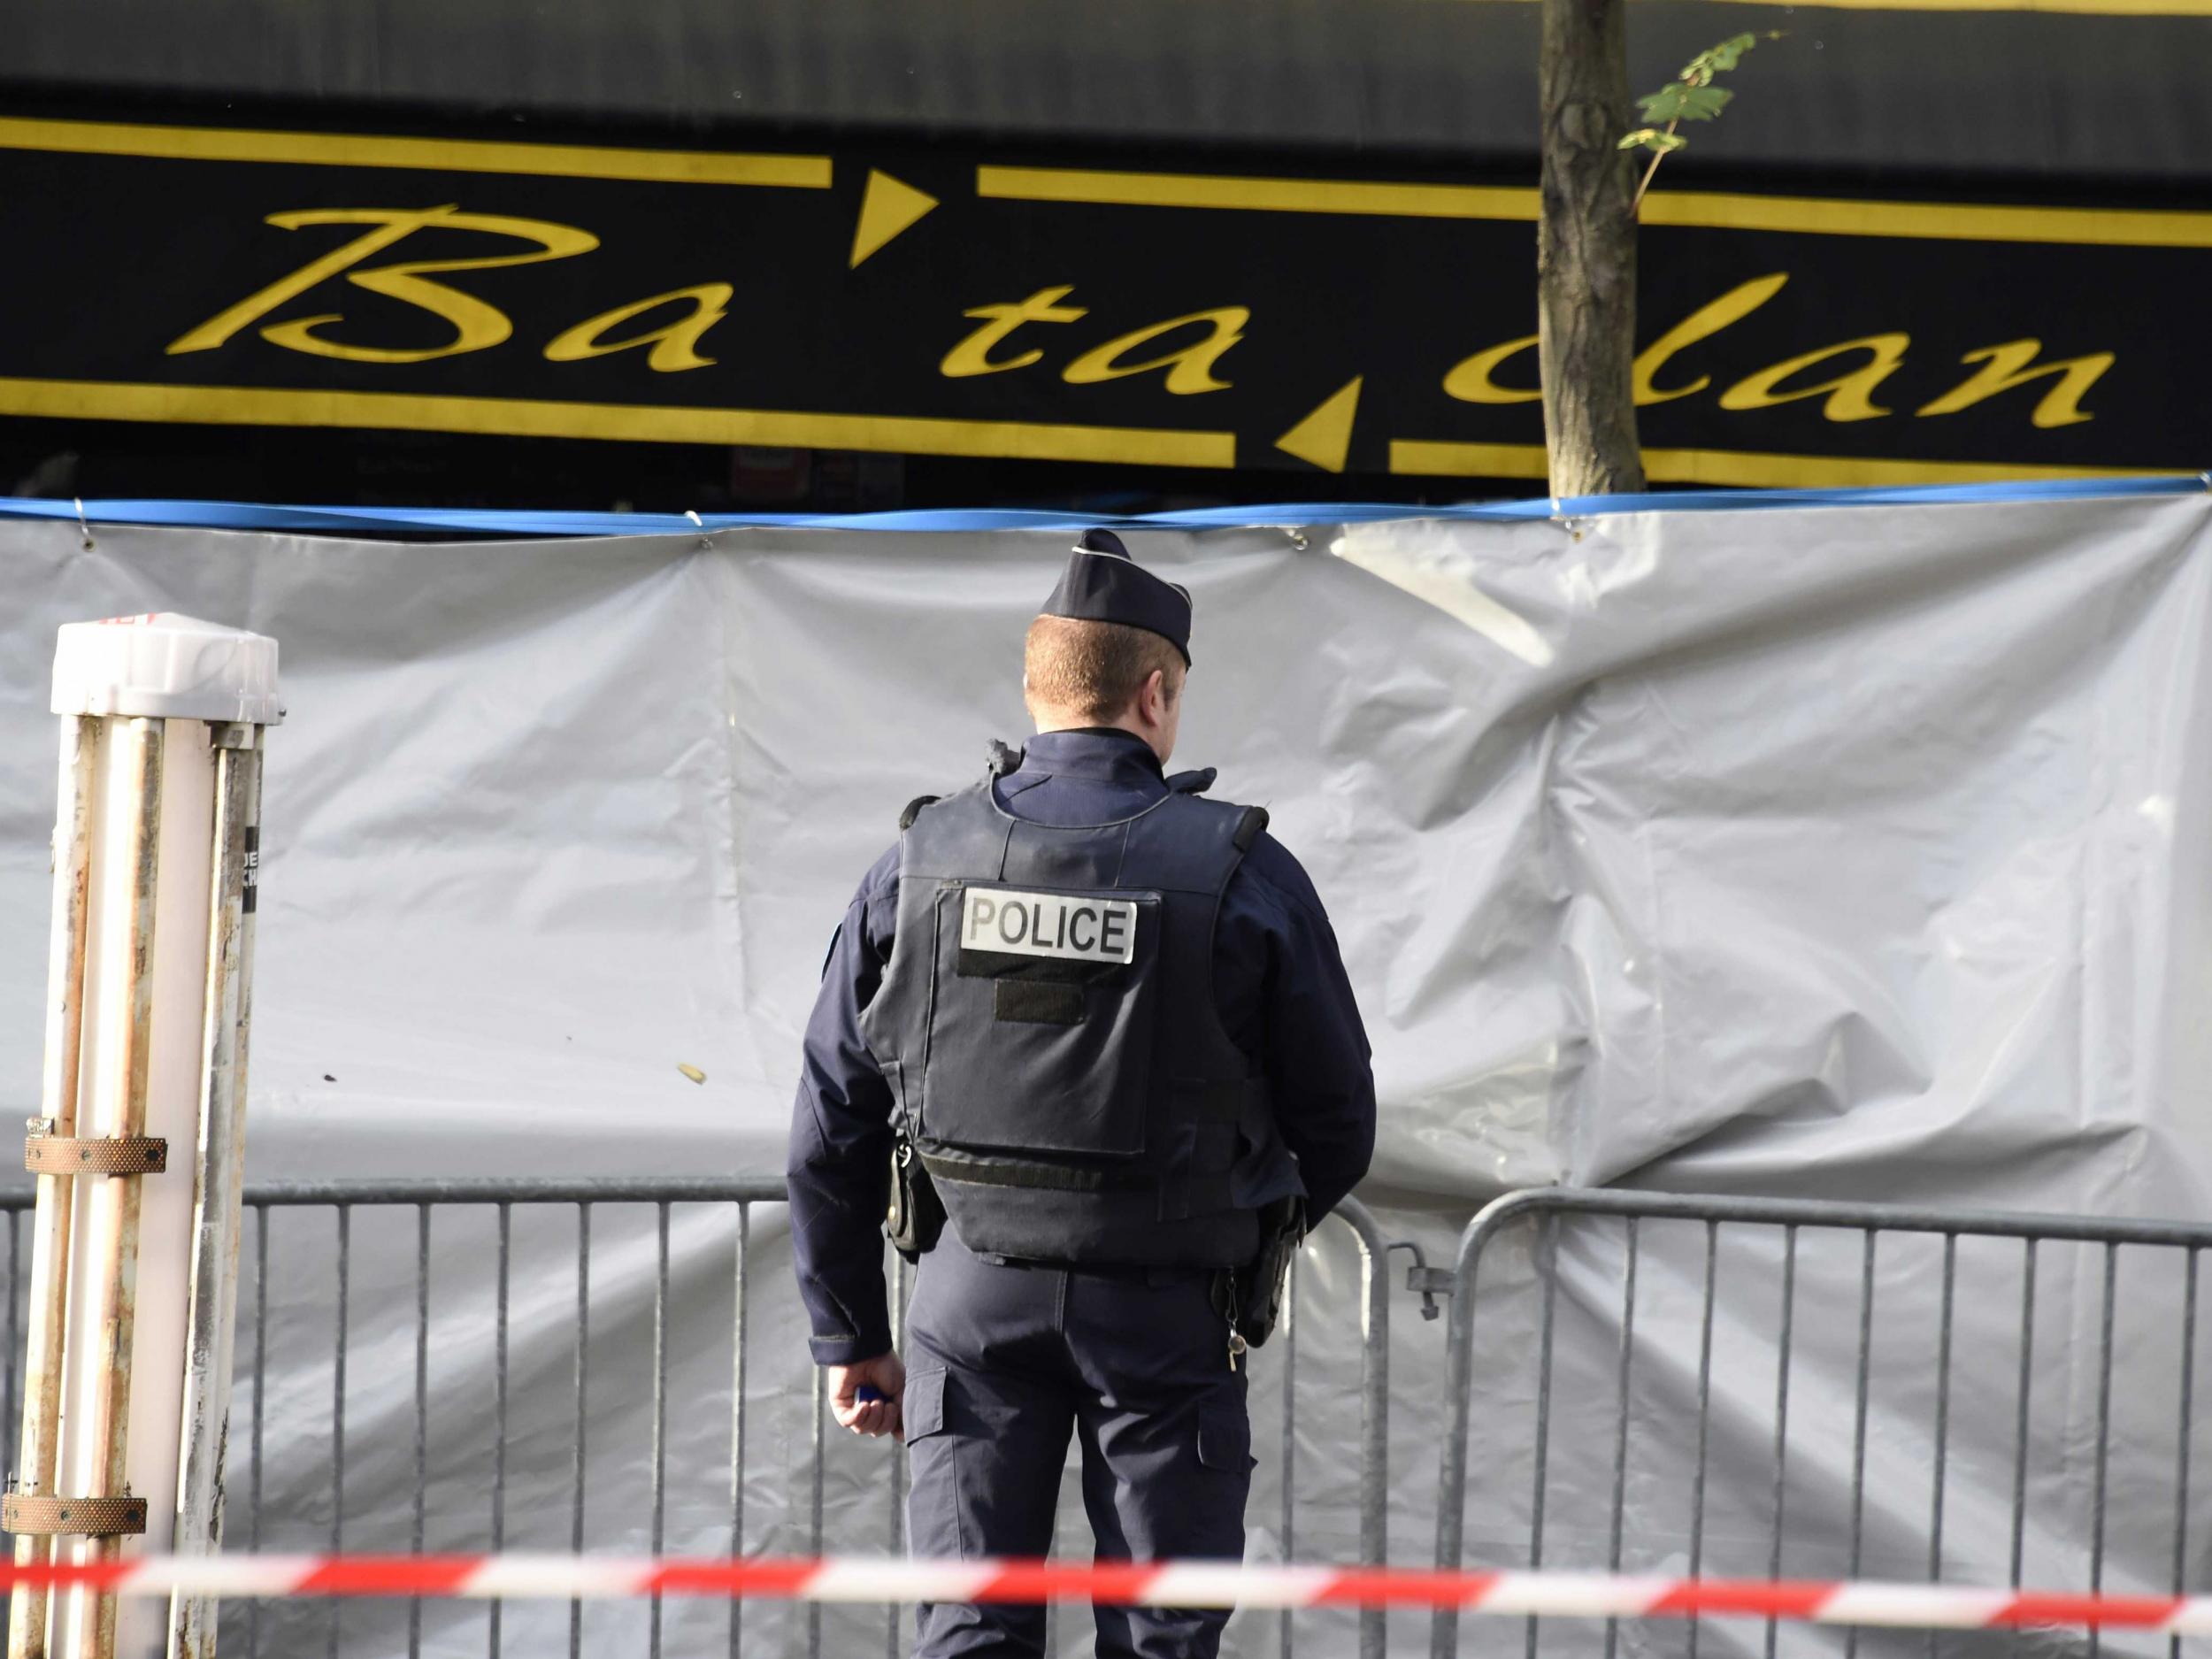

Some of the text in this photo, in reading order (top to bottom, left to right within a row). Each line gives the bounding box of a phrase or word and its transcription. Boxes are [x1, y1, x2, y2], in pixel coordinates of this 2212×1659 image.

[166, 204, 734, 373] Ba
[940, 285, 1250, 396] ta
[970, 897, 1127, 955] POLICE
